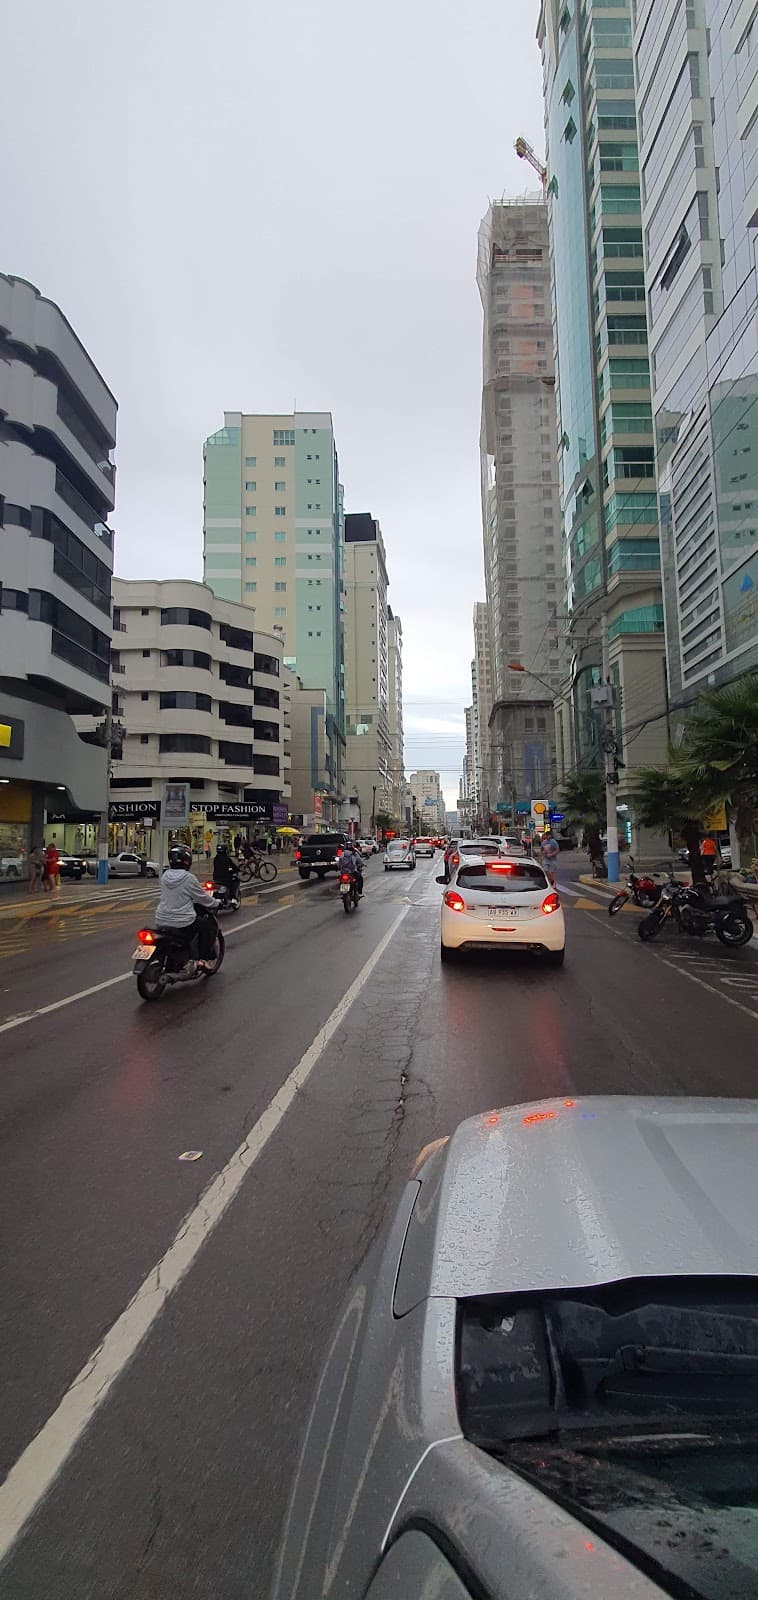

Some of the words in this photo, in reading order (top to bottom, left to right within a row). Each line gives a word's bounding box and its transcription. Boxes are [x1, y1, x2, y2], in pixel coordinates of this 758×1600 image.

[110, 803, 157, 813] ASHION
[191, 804, 220, 813] STOP
[222, 804, 266, 813] FASHION
